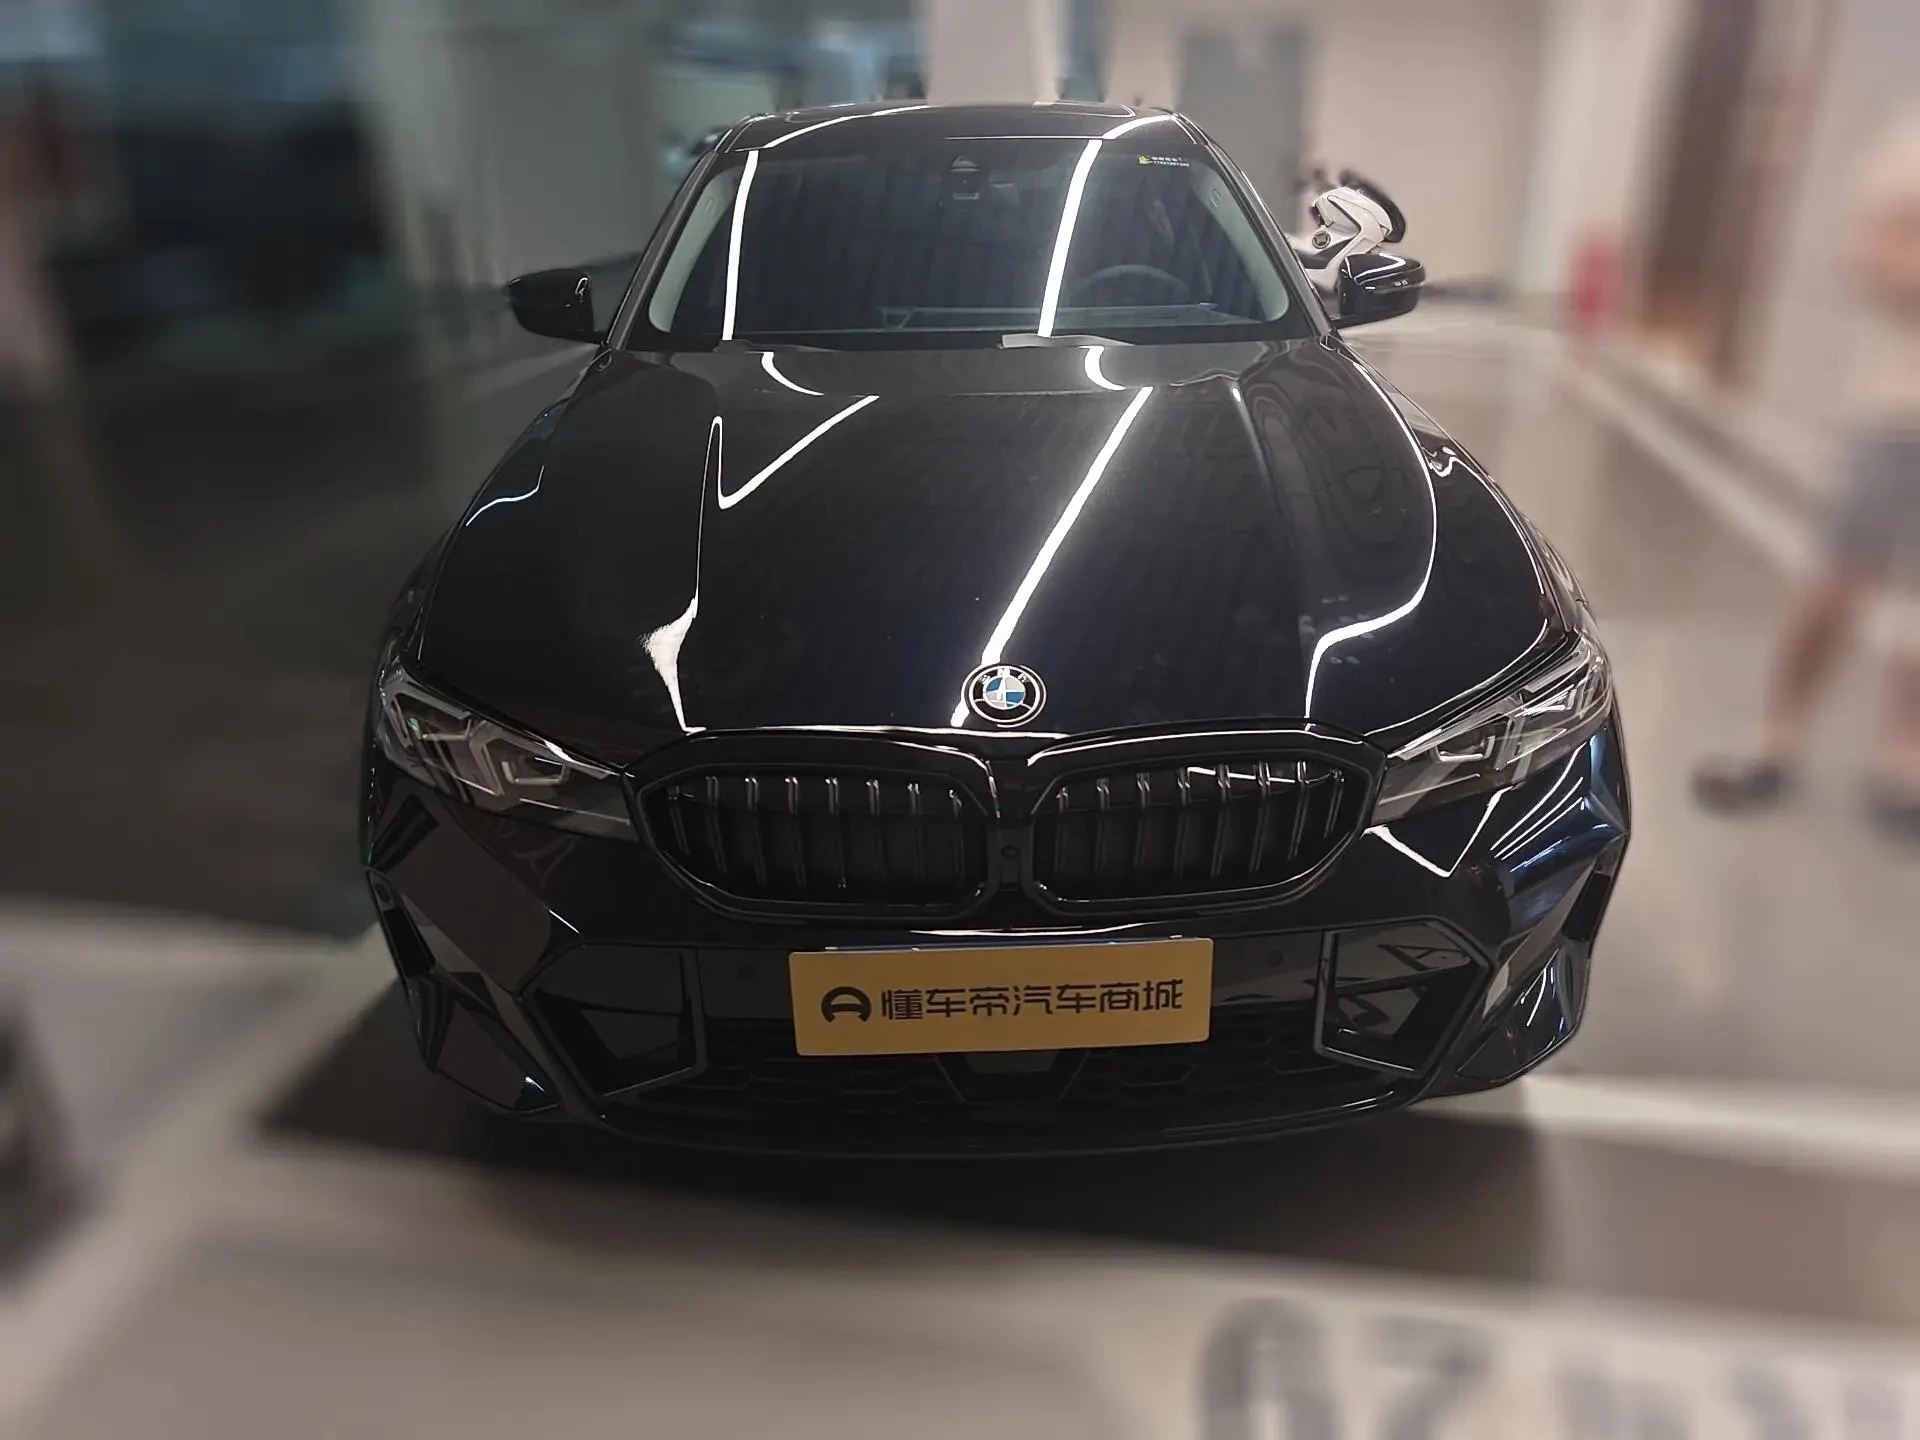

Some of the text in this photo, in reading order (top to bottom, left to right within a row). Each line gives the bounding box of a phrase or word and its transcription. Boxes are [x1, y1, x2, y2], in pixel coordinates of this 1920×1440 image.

[881, 978, 1184, 1020] 懂车帝汽车商城
